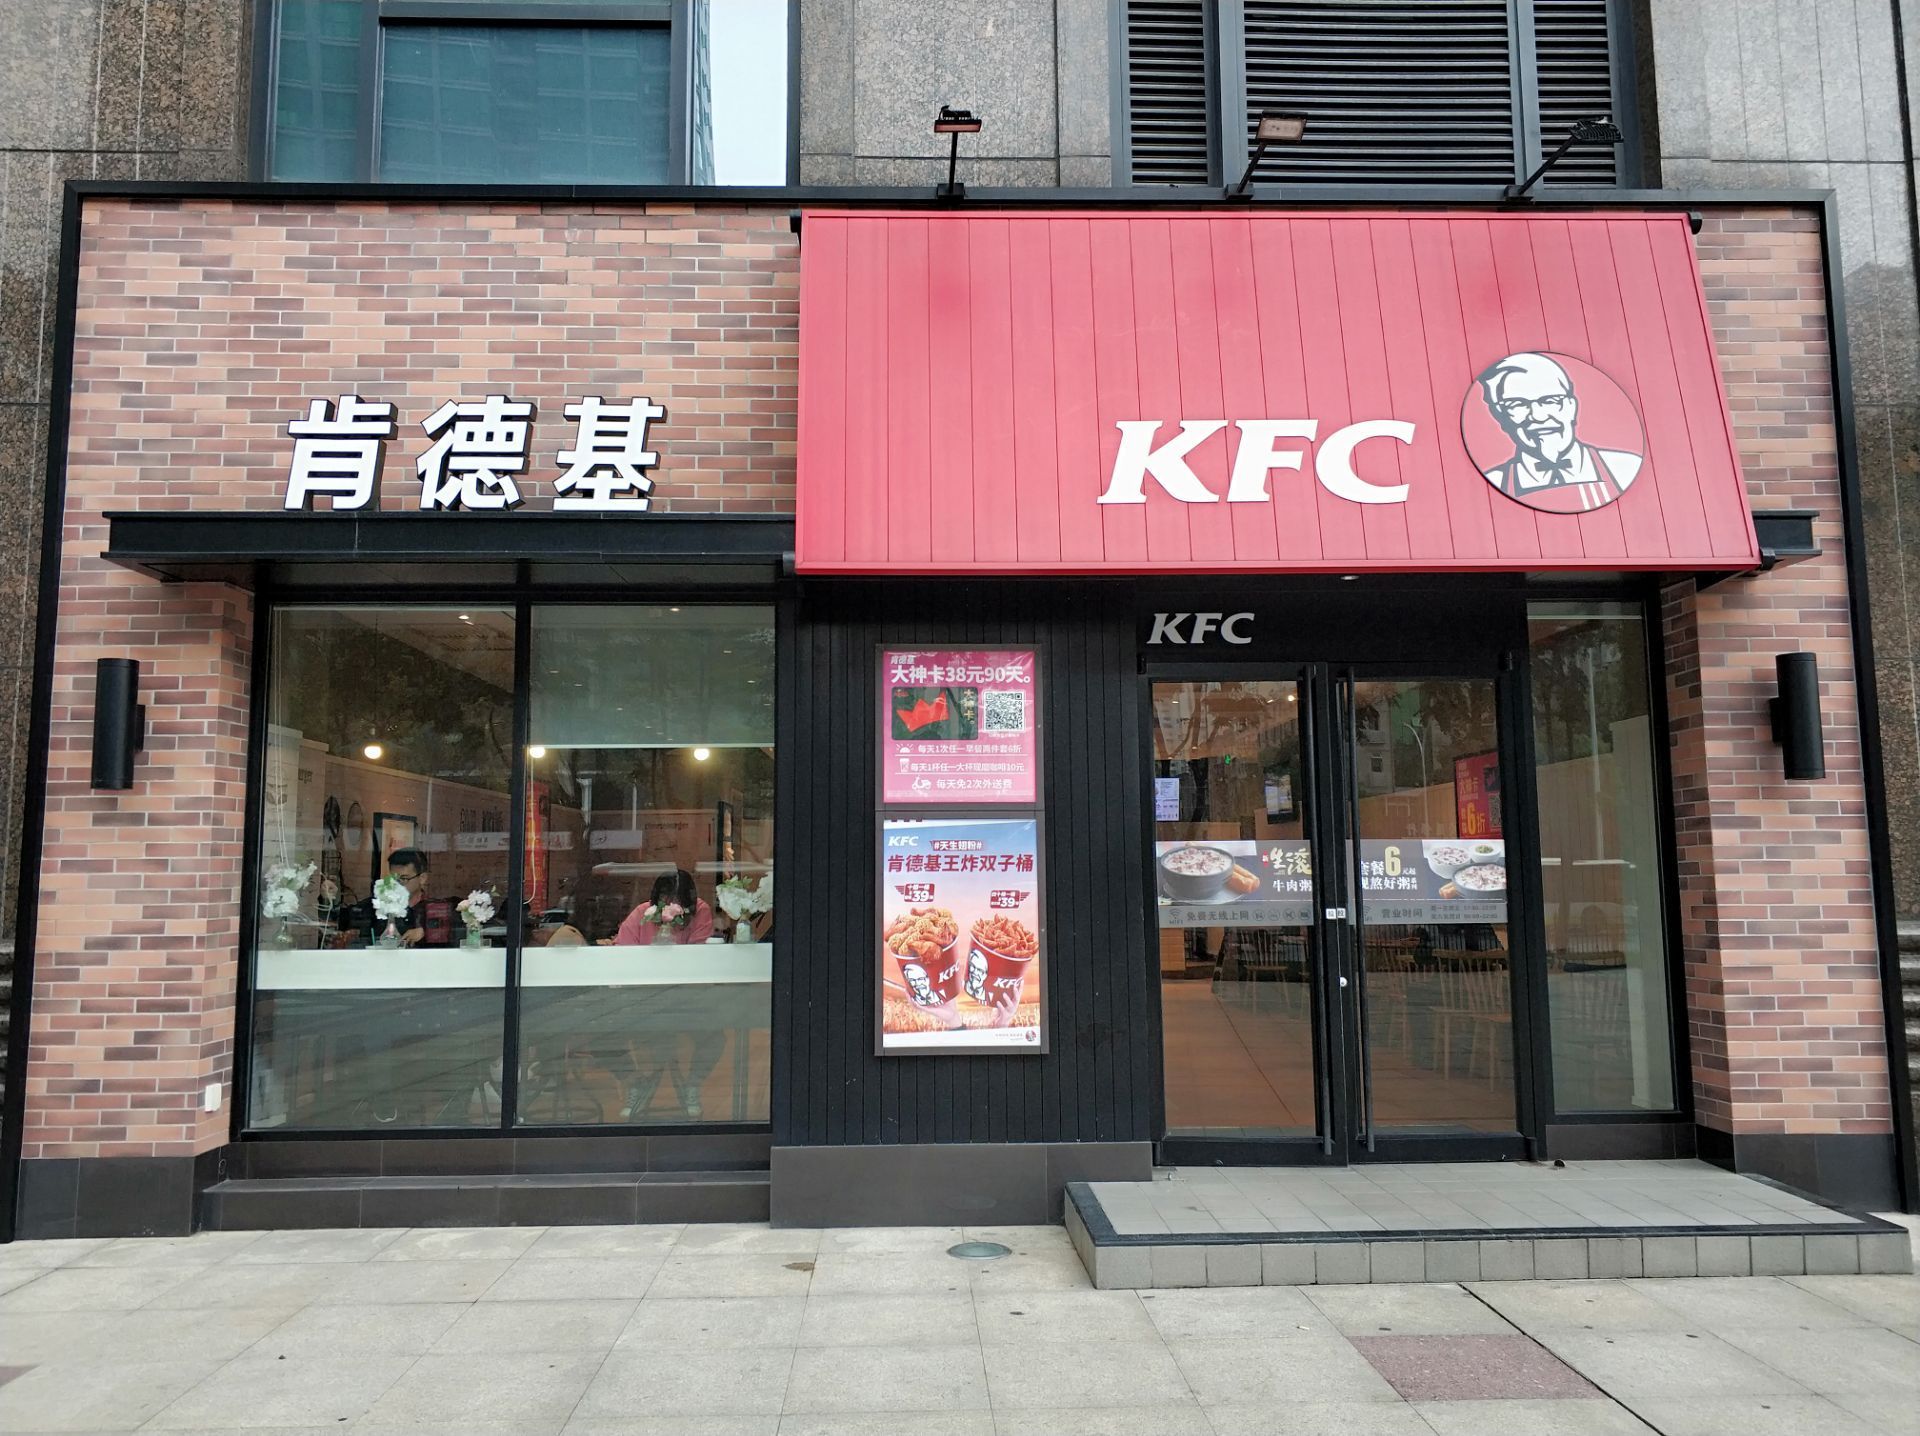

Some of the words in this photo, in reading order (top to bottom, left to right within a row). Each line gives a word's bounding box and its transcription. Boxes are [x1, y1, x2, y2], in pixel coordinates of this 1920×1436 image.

[284, 395, 668, 512] 肯德基
[1096, 419, 1416, 504] KFC
[1146, 612, 1255, 644] KFC
[891, 665, 1031, 684] 大神卡38元90天。
[937, 779, 1013, 789] 每天免2次外送费
[888, 836, 919, 846] KFC
[933, 840, 983, 851] #天生翅粉#
[888, 854, 1034, 872] 肯德基王炸双子桶
[1187, 910, 1249, 921] 免费无线上网
